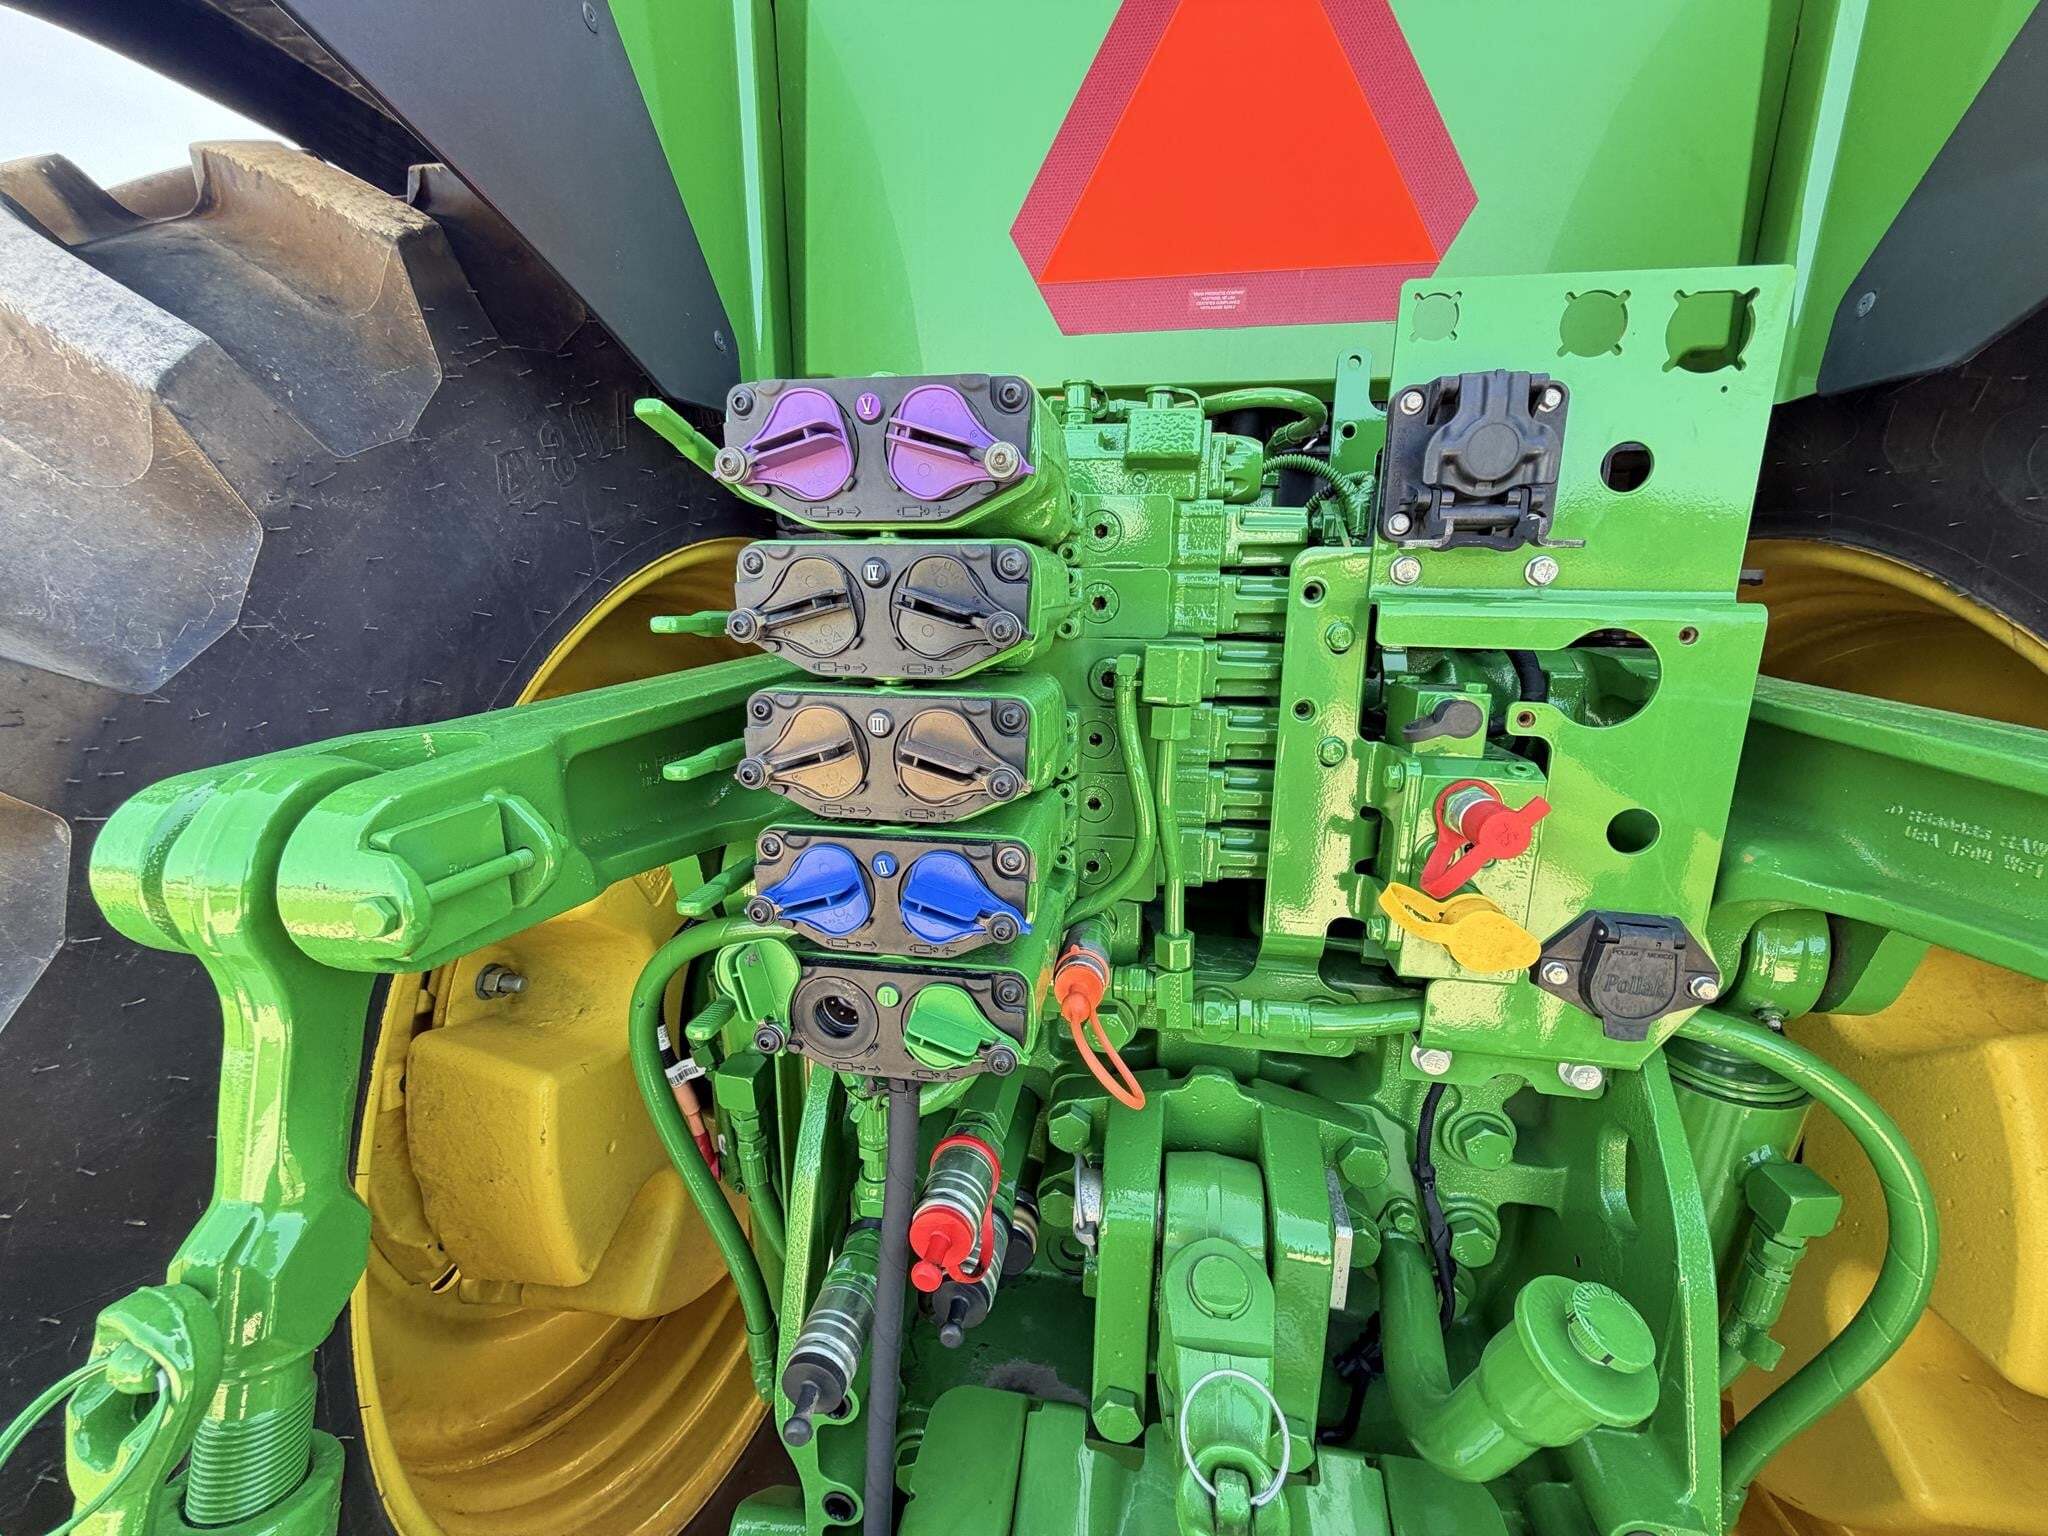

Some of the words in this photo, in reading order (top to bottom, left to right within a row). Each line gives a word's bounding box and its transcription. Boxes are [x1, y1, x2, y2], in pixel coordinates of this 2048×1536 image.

[861, 397, 872, 414] V
[865, 564, 880, 581] IV
[871, 717, 885, 733] III
[877, 860, 890, 875] II
[1603, 973, 1665, 998] Pollak
